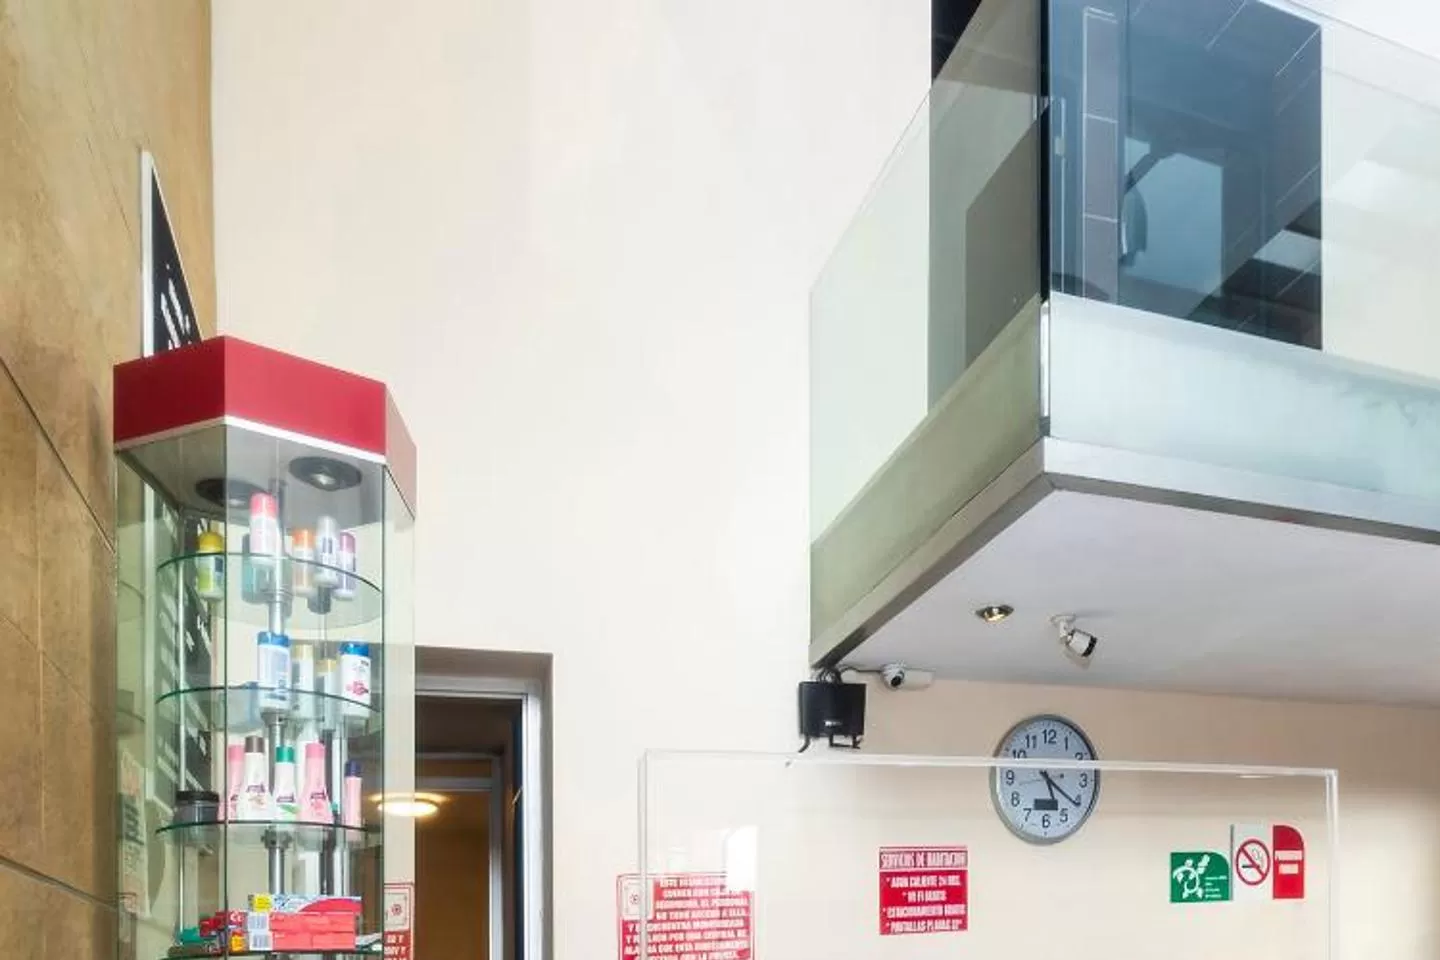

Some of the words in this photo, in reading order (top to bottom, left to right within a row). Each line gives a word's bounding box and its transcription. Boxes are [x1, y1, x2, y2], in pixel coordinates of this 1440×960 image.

[1025, 734, 1037, 749] 11
[1041, 729, 1057, 744] 12
[1064, 736, 1069, 750] 1
[1005, 770, 1015, 786] 9
[1079, 773, 1088, 788] 3
[1011, 791, 1020, 807] 8
[1023, 808, 1032, 822] 7
[1042, 814, 1051, 828] 6
[1060, 808, 1069, 822] 5
